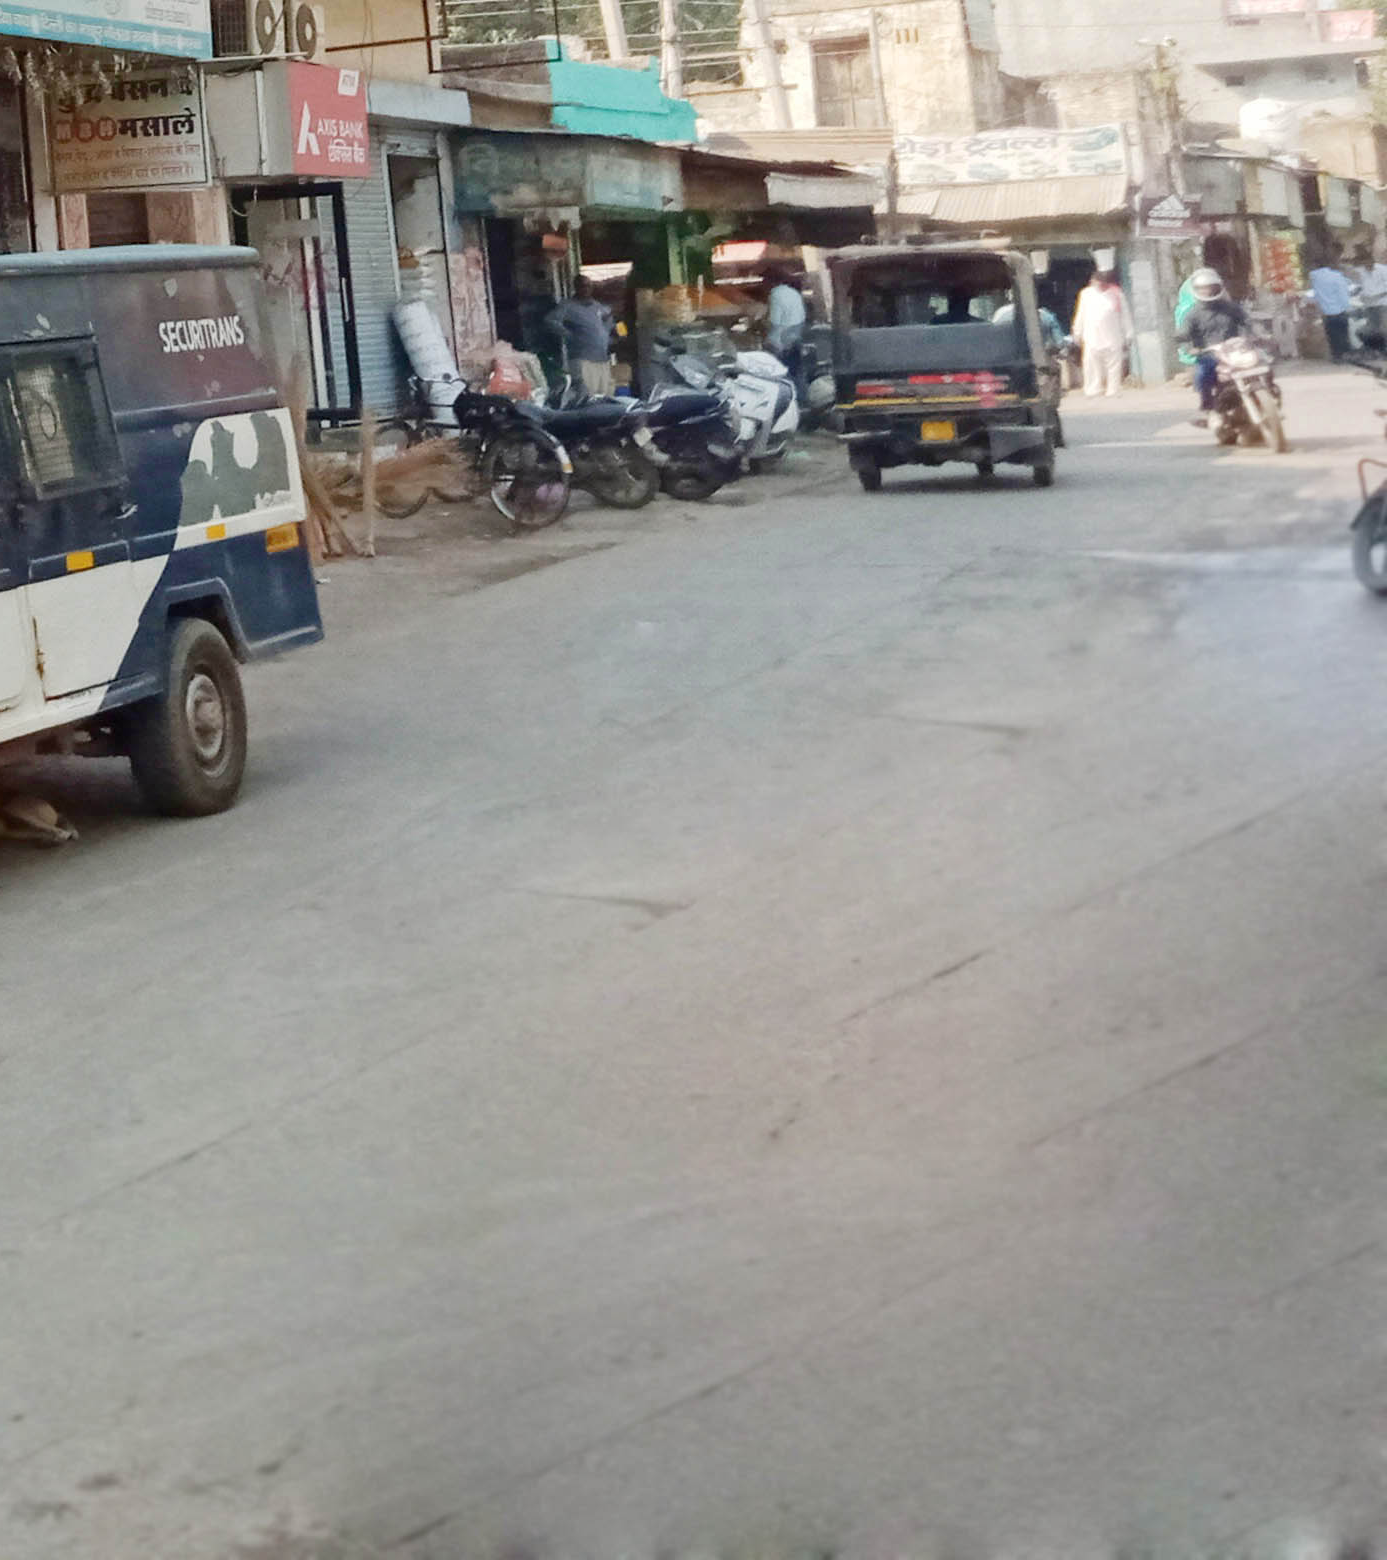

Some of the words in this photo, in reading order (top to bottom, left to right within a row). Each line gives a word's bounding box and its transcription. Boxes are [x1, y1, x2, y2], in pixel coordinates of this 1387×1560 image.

[317, 118, 337, 137] AXIS
[338, 119, 364, 139] BANK
[158, 316, 245, 354] SECURITRANS
